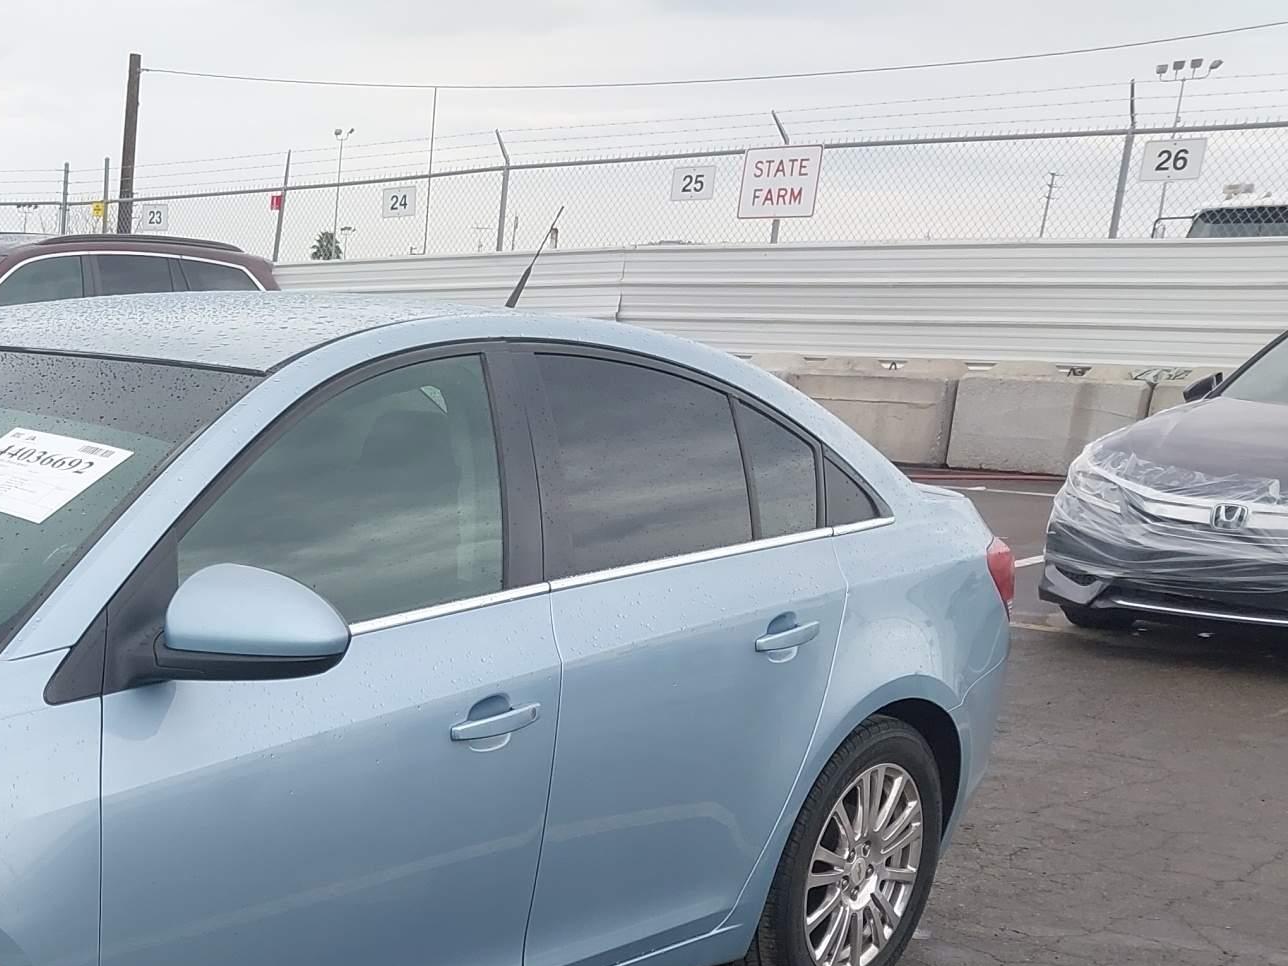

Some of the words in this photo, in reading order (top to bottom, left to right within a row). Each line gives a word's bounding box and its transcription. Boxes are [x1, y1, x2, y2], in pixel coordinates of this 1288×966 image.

[753, 158, 810, 178] STATE
[1154, 148, 1189, 171] 26
[681, 174, 705, 193] 25
[390, 194, 408, 211] 24
[751, 187, 803, 206] FARM
[148, 209, 162, 225] 23
